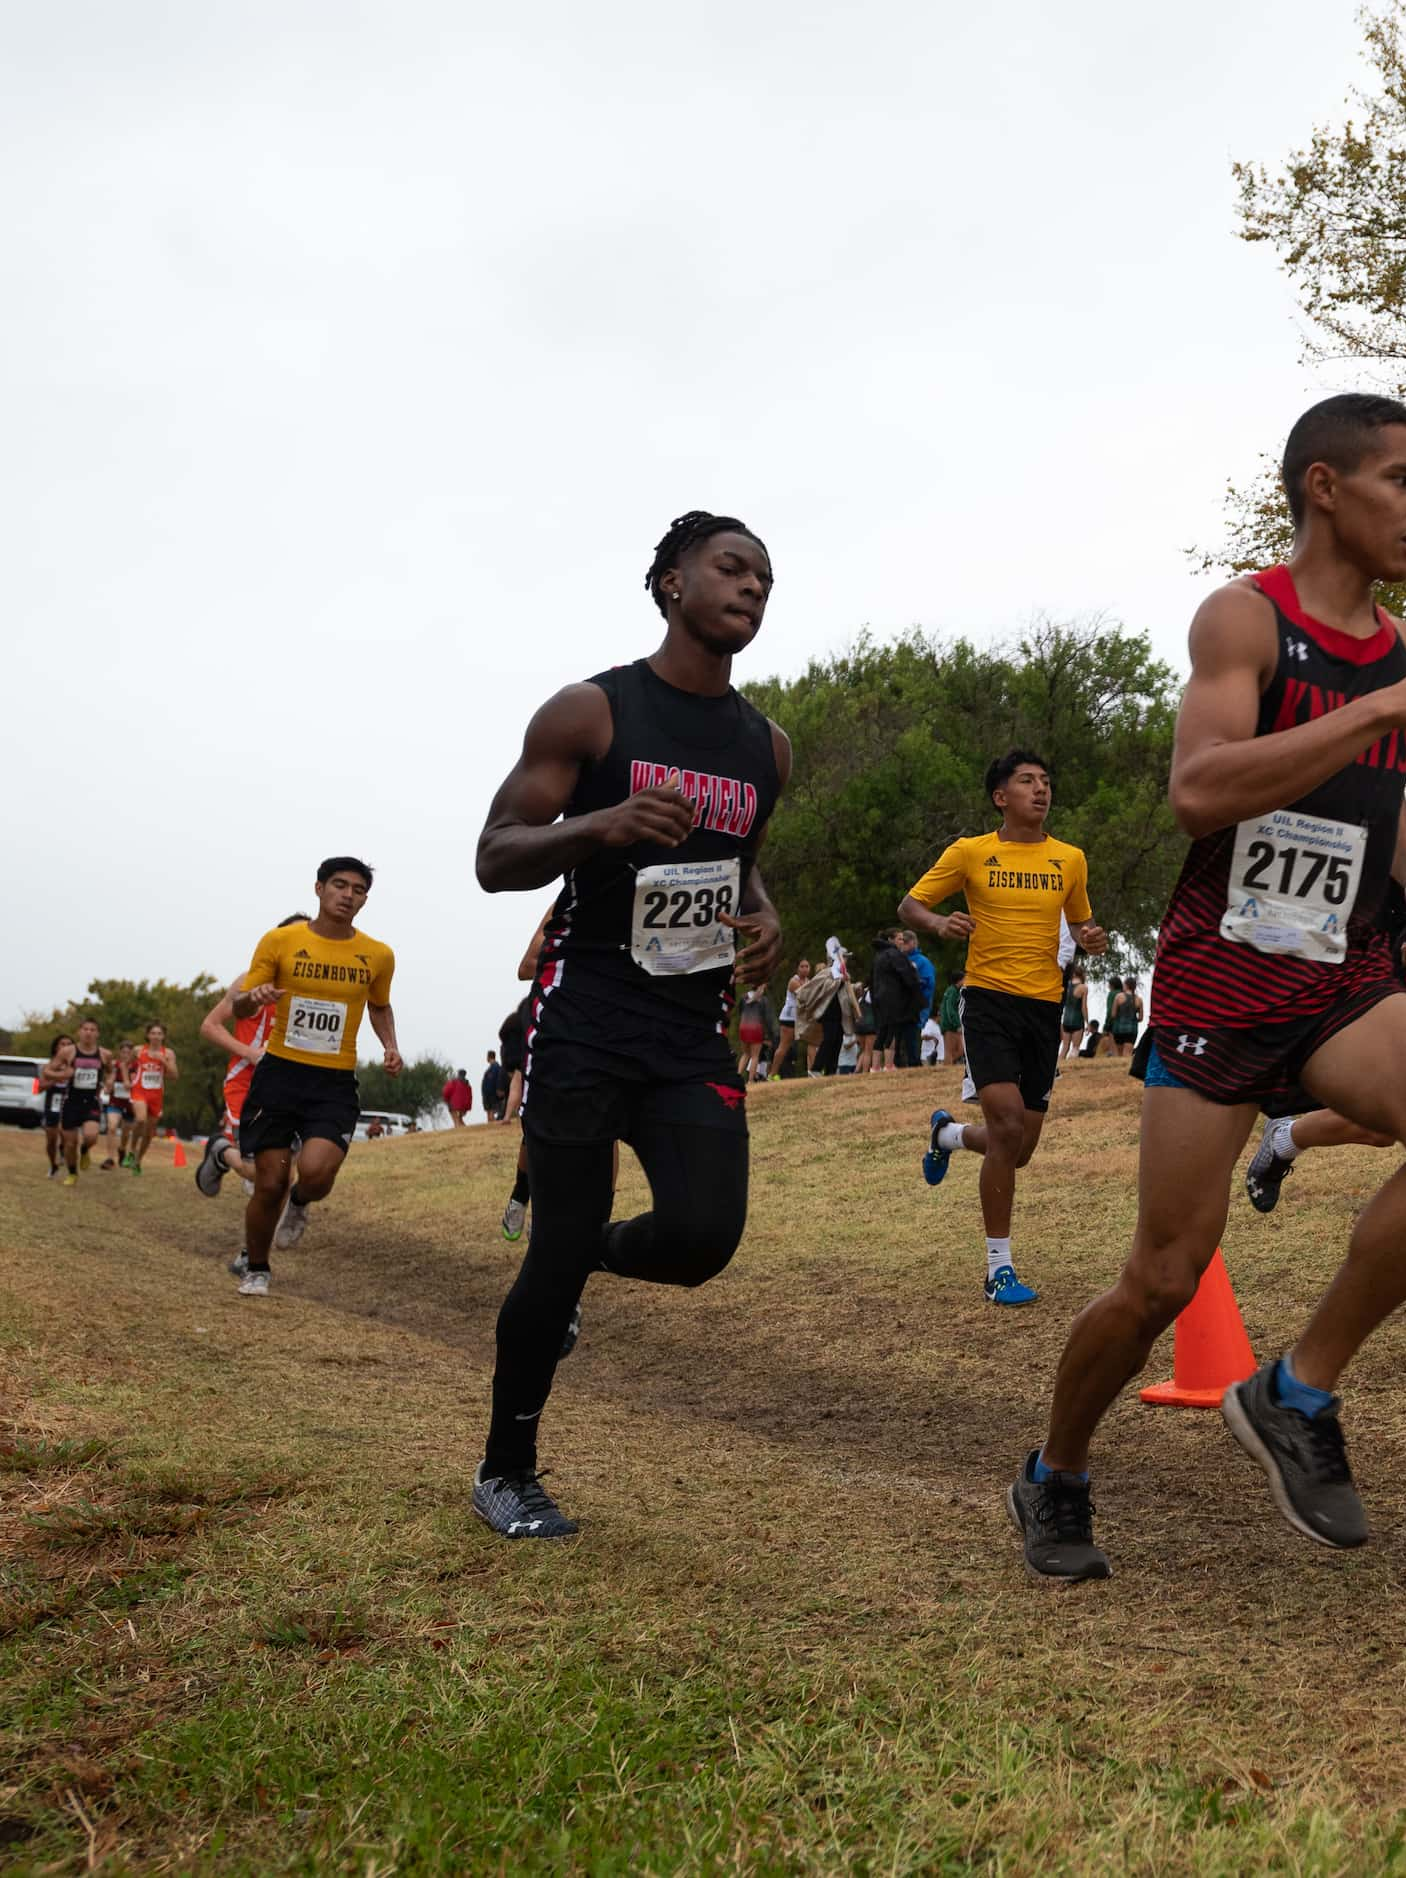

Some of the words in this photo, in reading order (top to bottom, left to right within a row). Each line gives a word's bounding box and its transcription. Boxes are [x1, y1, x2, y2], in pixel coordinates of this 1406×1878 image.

[630, 760, 758, 839] WTFIELD
[1273, 813, 1293, 827] UIL
[1296, 818, 1334, 836] Region
[1256, 824, 1273, 836] XC
[1276, 830, 1353, 852] Championship
[670, 875, 730, 888] Championshi
[682, 866, 714, 876] Region
[988, 870, 1064, 892] EISENHOWER
[1243, 840, 1353, 905] 2175
[643, 885, 733, 929] 2238
[292, 960, 373, 986] EISENHOWER
[293, 1009, 341, 1033] 2100
